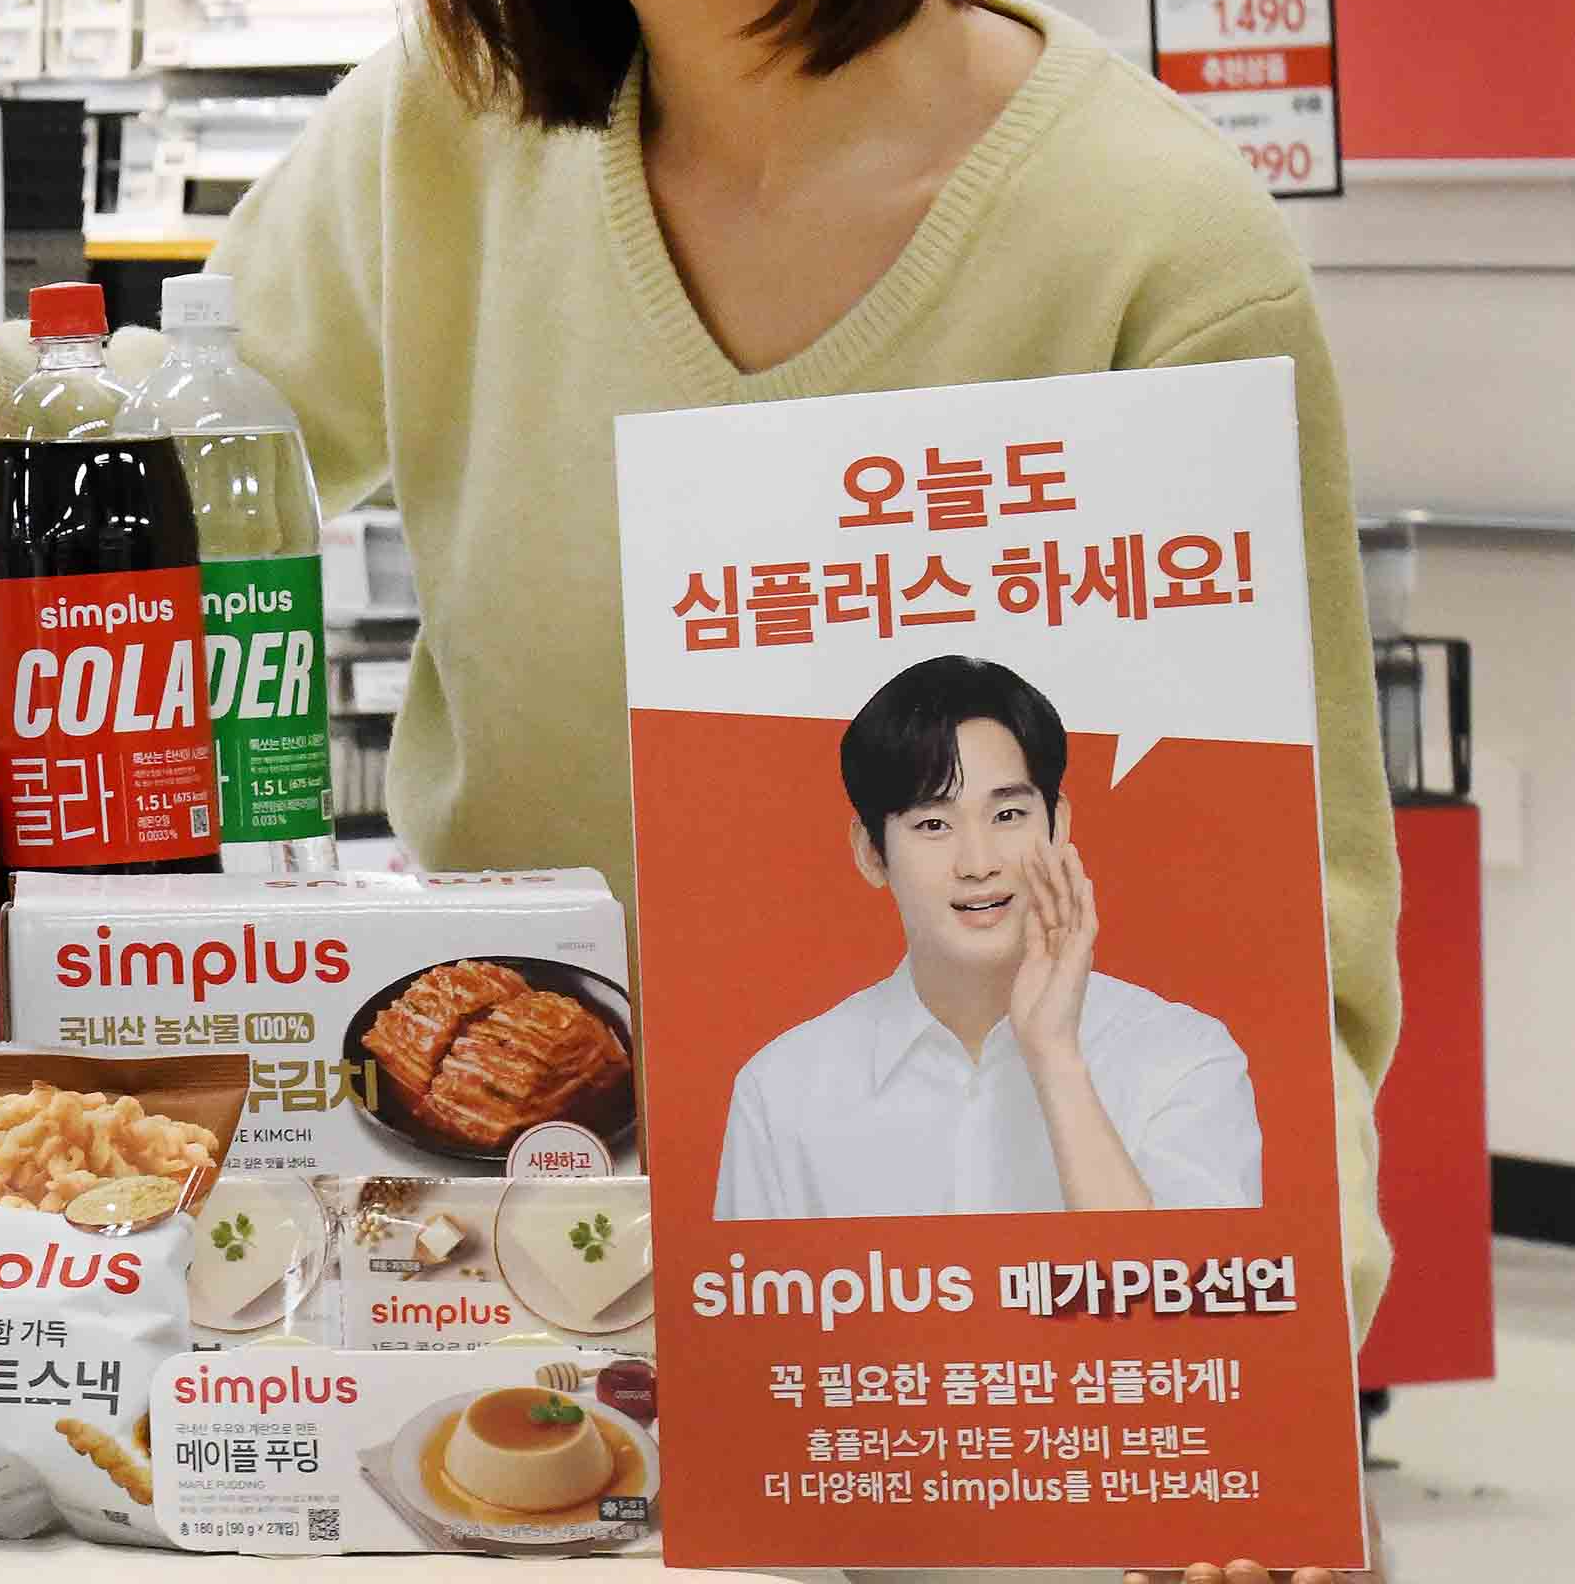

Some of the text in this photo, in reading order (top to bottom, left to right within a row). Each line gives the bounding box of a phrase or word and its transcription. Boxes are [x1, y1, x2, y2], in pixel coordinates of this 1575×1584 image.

[838, 440, 1077, 532] 오늘도
[672, 530, 1254, 652] 심플러스 하세요!
[40, 593, 173, 633] simplus
[13, 639, 195, 739] COLA
[10, 753, 114, 847] 콜라
[137, 795, 173, 812] 1.5 L
[251, 778, 288, 796] 1.5 L
[56, 924, 352, 1002] simplus
[59, 1016, 309, 1048] 국내산 농산물 100%
[254, 1128, 313, 1143] KIMCHI
[528, 1152, 592, 1171] 시원하고
[691, 1251, 1298, 1332] simplus 메가PB선언
[20, 1319, 68, 1348] 가득
[371, 1296, 512, 1331] simplus
[174, 1365, 359, 1414] simplus
[769, 1357, 1243, 1407] 꼭 필요한 품질만 심플하게!
[176, 1439, 319, 1473] 메이플 푸딩
[806, 1426, 1210, 1460] 홈플러스가 만든 가성비 브랜드
[764, 1470, 1261, 1510] 더 다양해진 simplus를 만나보세요!
